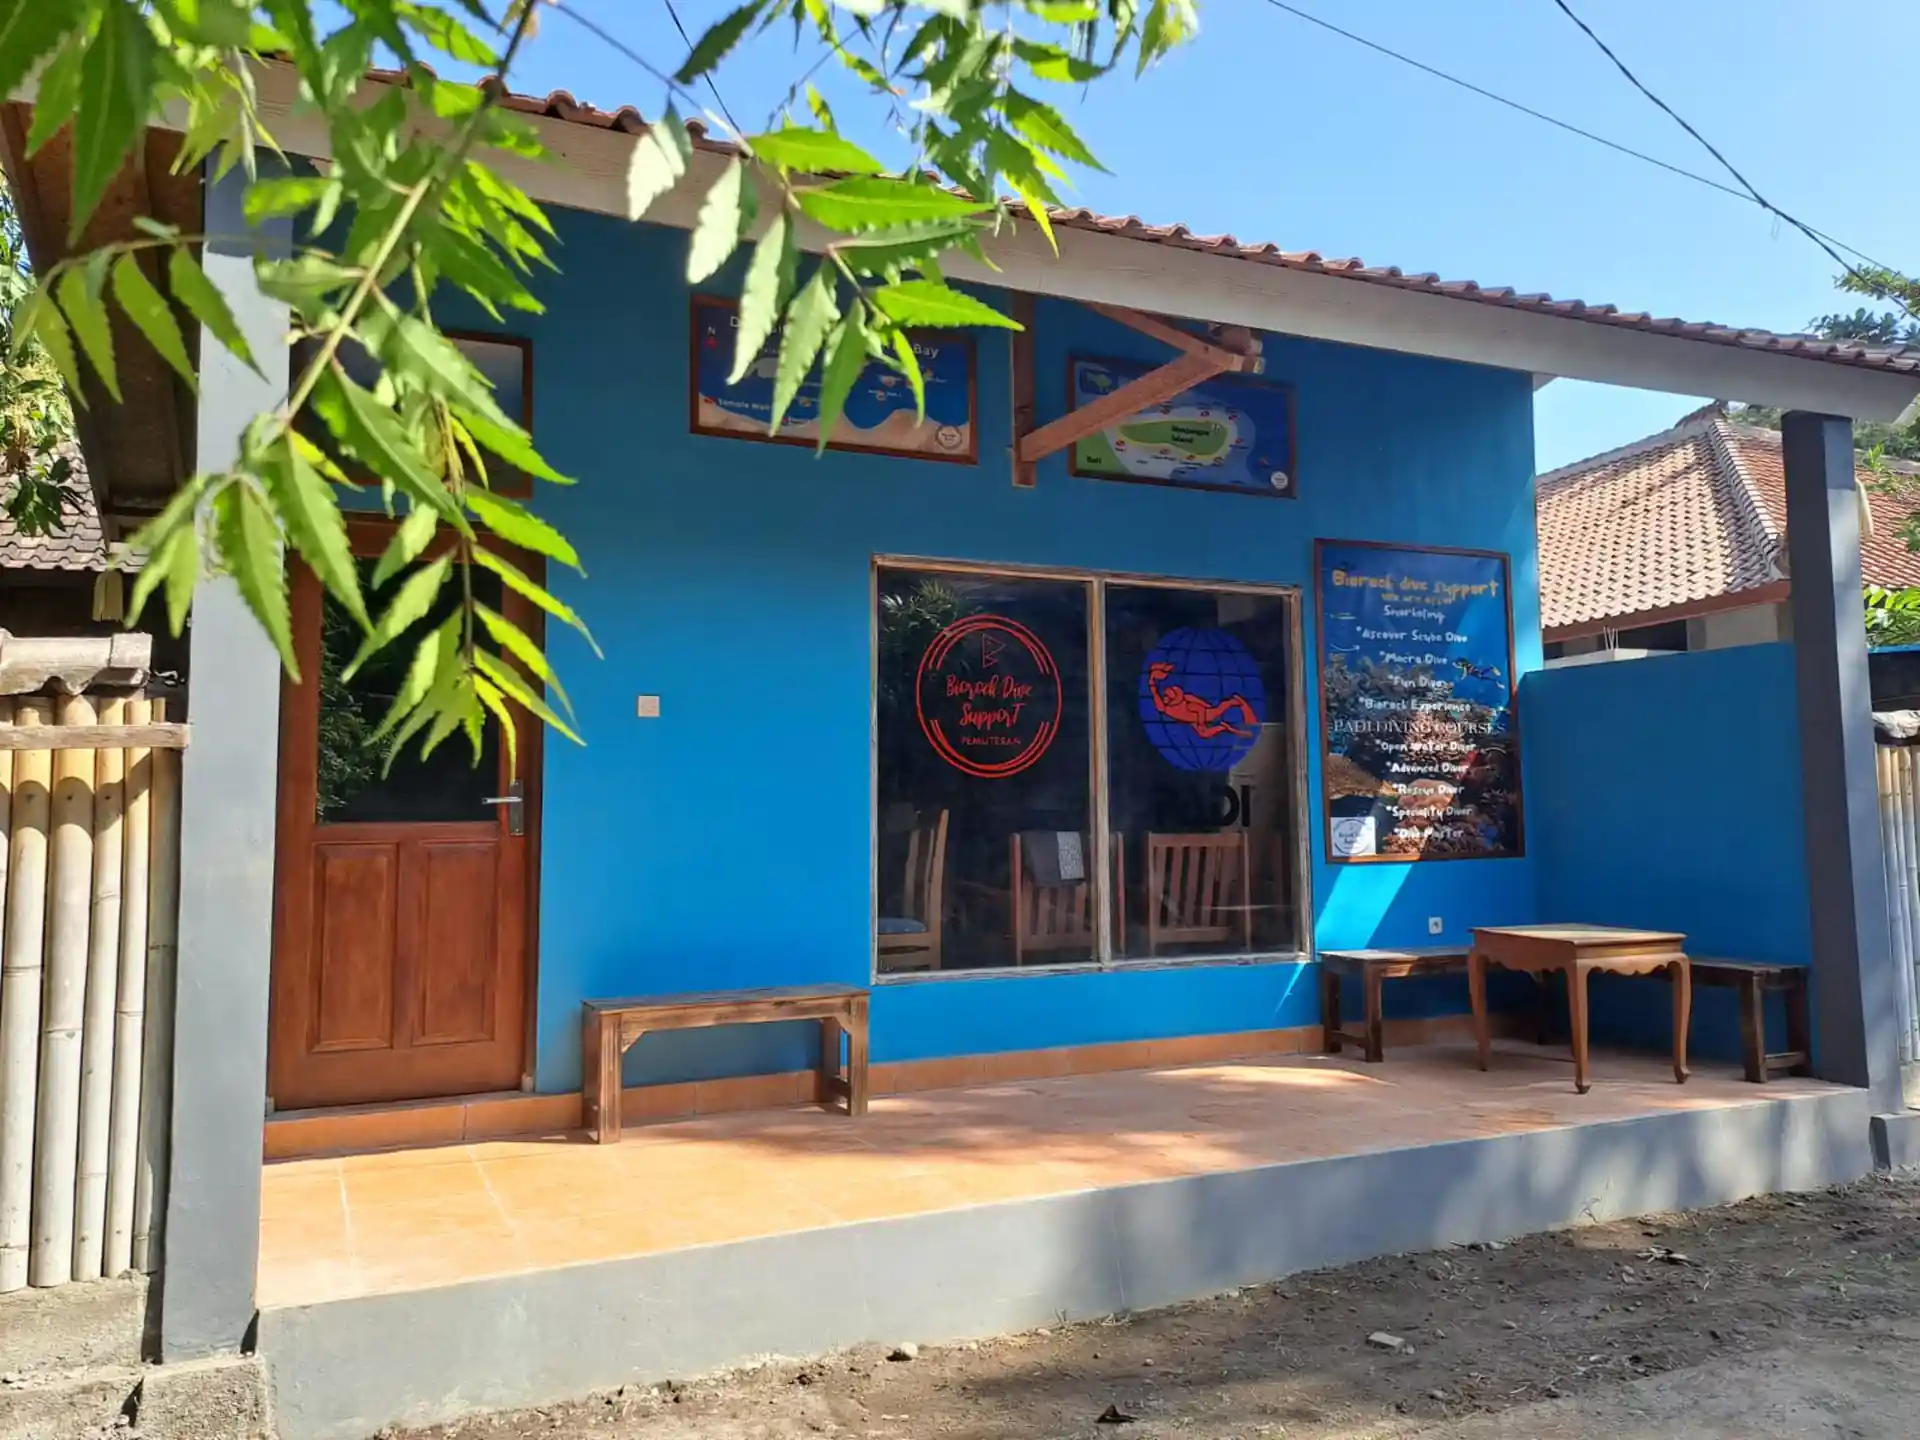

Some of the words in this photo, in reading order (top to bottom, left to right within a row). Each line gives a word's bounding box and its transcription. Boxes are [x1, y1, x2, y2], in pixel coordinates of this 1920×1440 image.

[914, 343, 939, 359] Bay
[1424, 653, 1448, 664] Dive
[1411, 699, 1471, 713] Experience
[1381, 741, 1408, 754] Open
[1390, 762, 1439, 774] Advanced
[1441, 762, 1469, 773] Diver
[1399, 783, 1434, 795] Rescue
[1438, 784, 1466, 795] Diver
